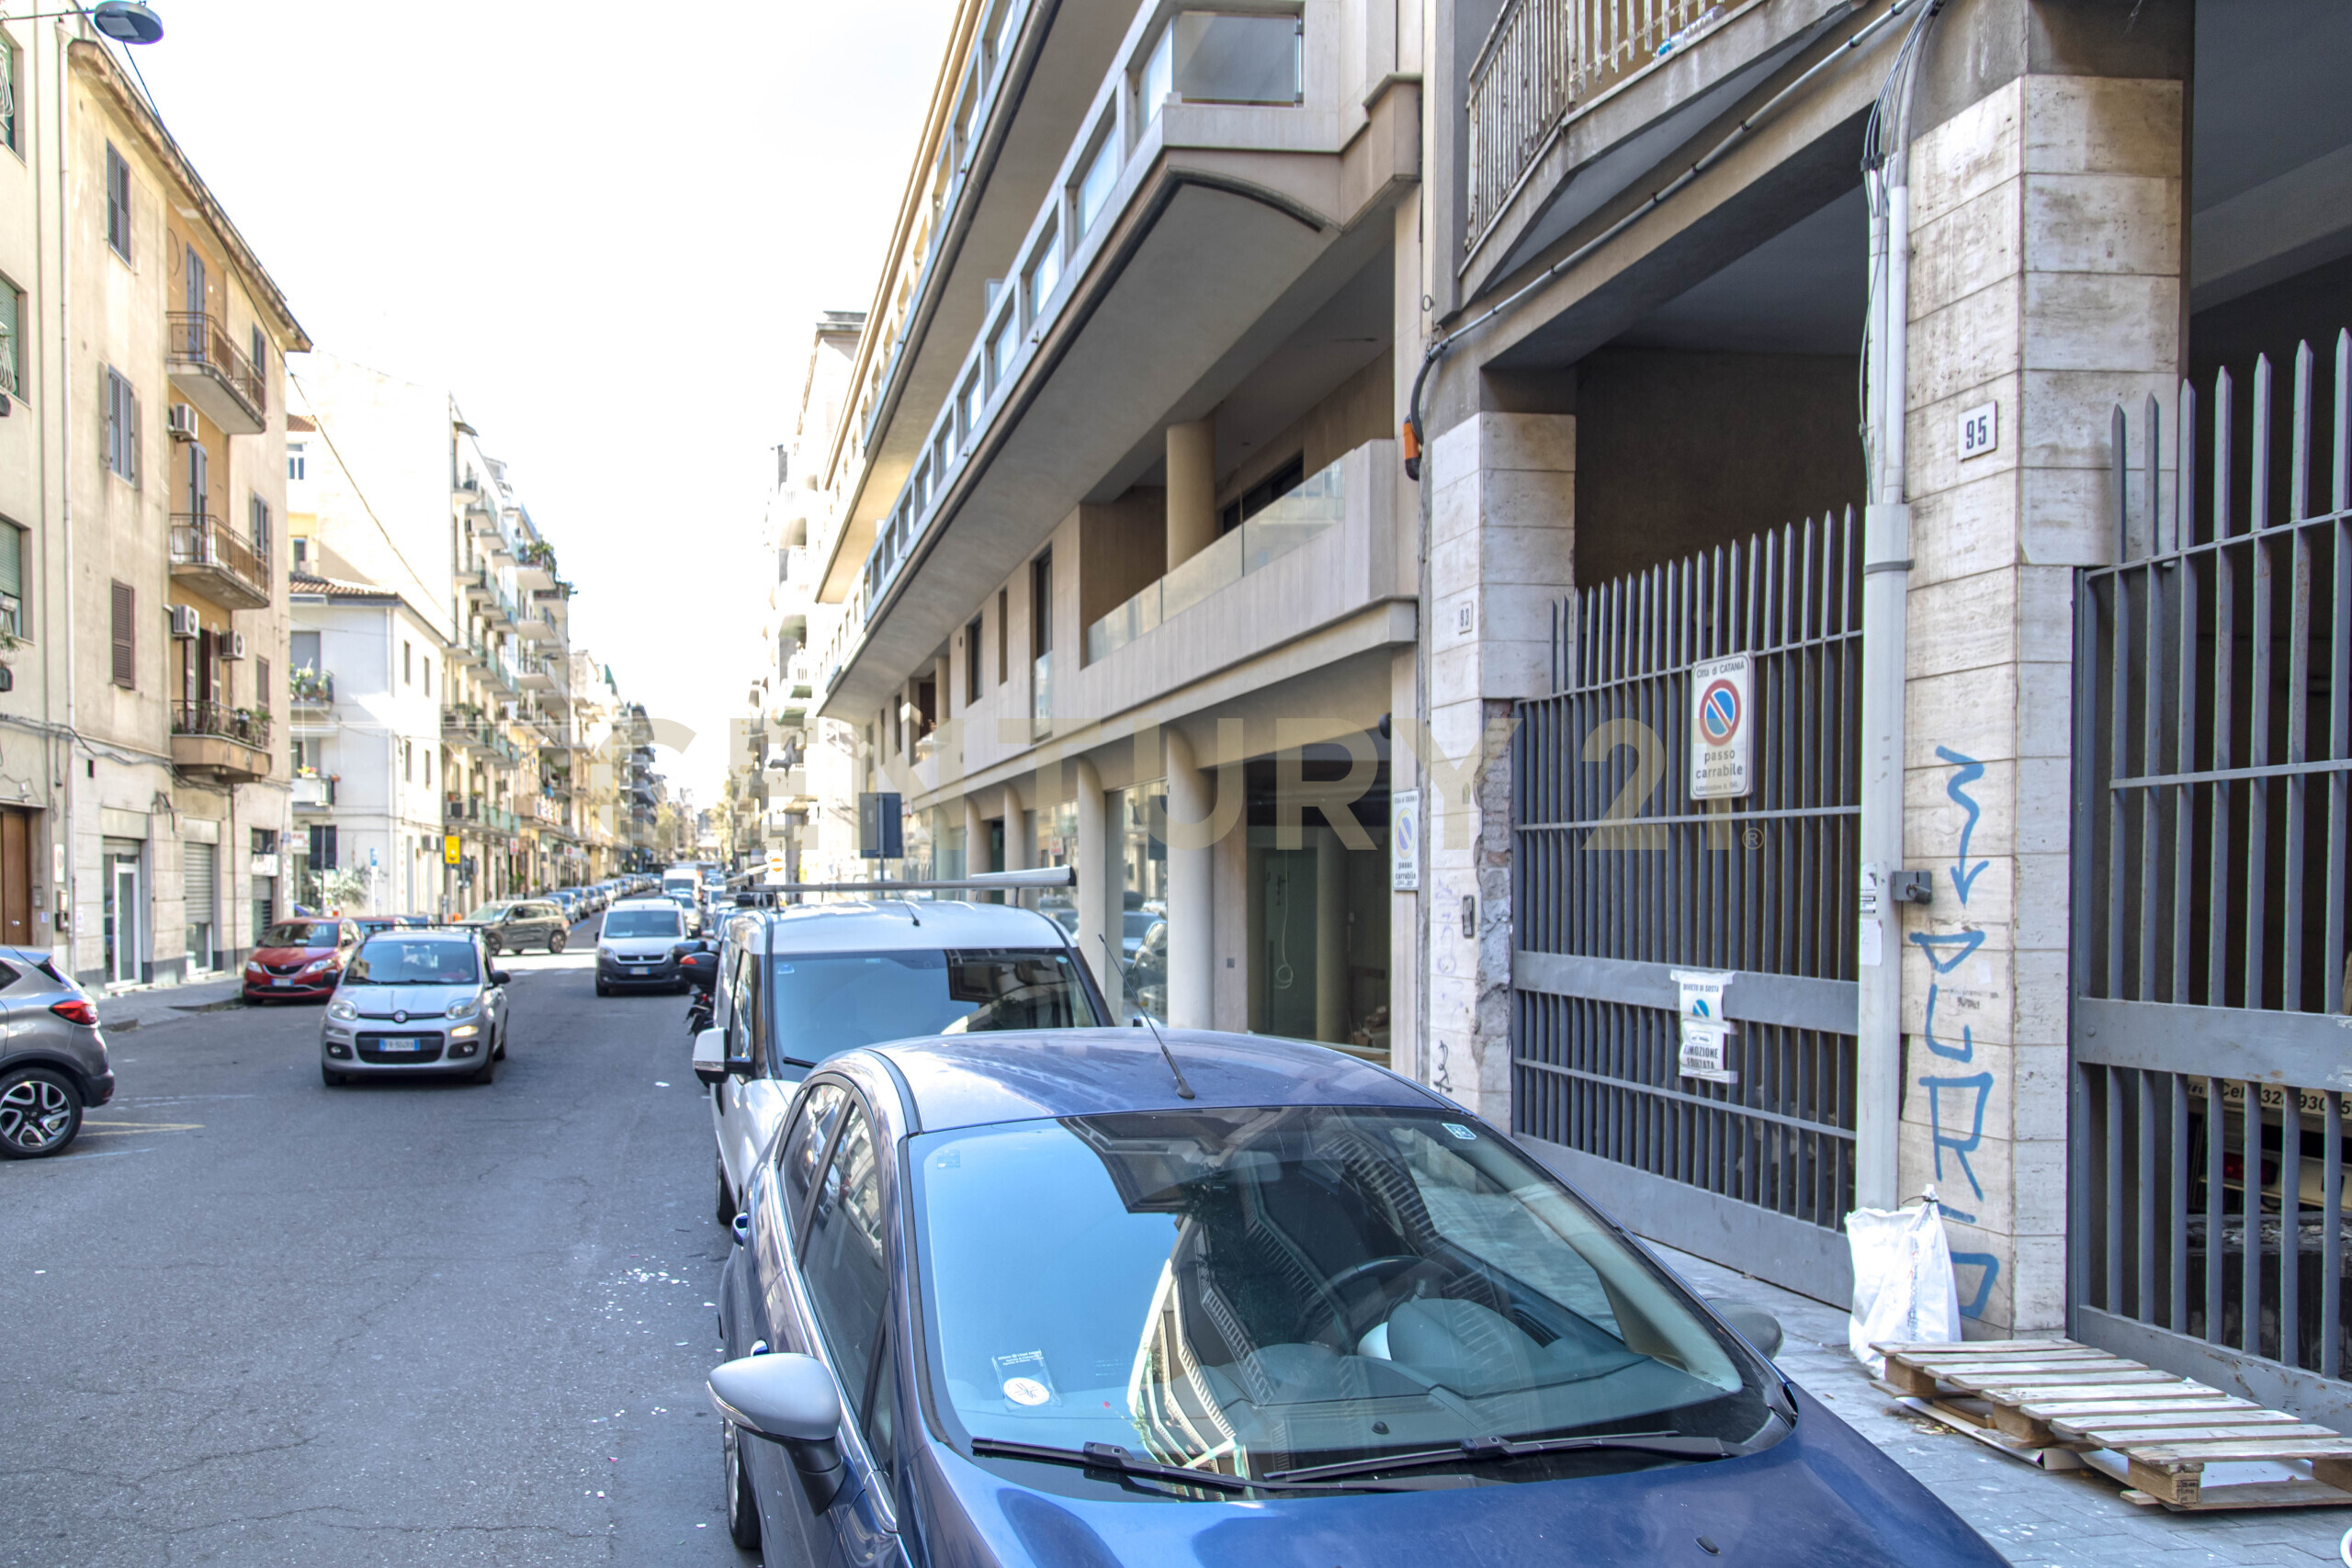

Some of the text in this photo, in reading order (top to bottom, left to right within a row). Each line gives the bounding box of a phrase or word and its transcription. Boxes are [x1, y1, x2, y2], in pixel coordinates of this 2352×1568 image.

[1966, 414, 1987, 450] 95
[1460, 608, 1470, 627] 93
[1720, 660, 1745, 674] CATANIA
[1704, 750, 1736, 764] passo
[1696, 763, 1743, 779] carrabile
[1700, 984, 1704, 992] DI
[1705, 985, 1719, 993] SOSTA
